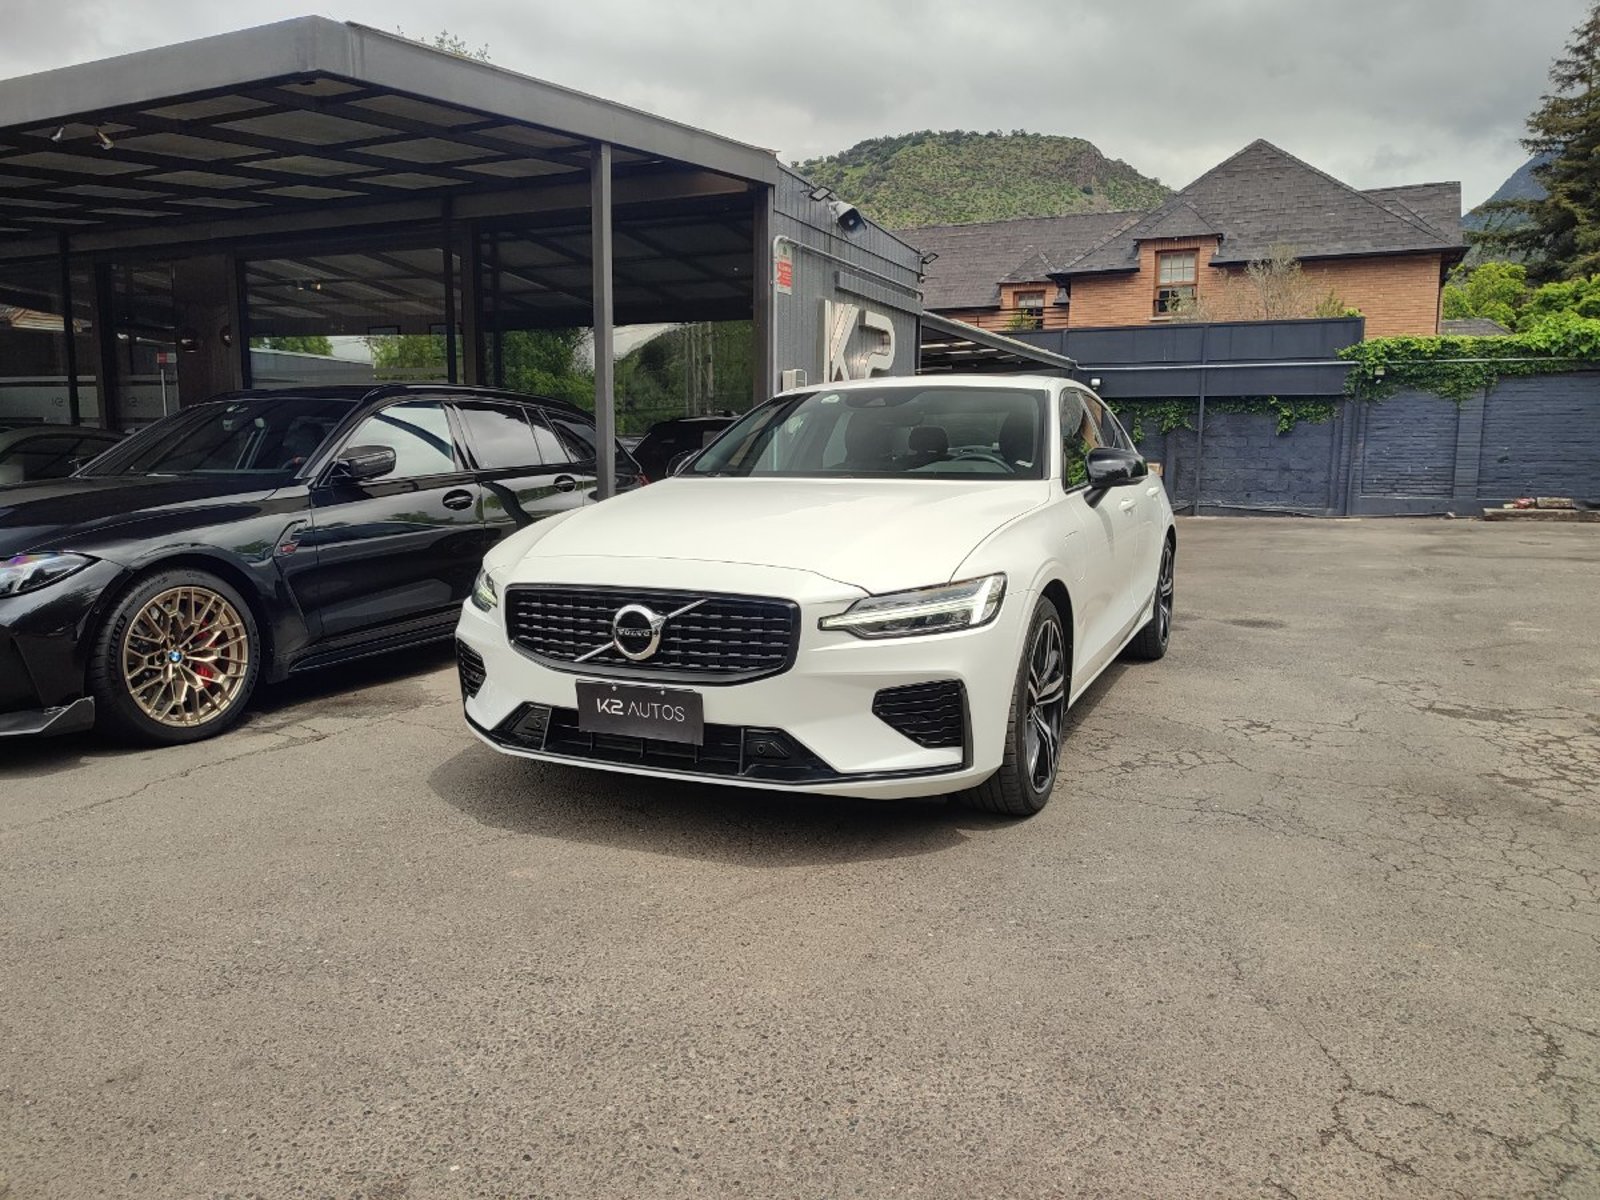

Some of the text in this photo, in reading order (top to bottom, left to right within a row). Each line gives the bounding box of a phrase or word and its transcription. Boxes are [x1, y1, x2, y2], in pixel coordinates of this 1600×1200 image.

[817, 299, 896, 383] K2
[617, 628, 650, 637] VOLVO
[596, 698, 685, 722] K2 AUTOS
